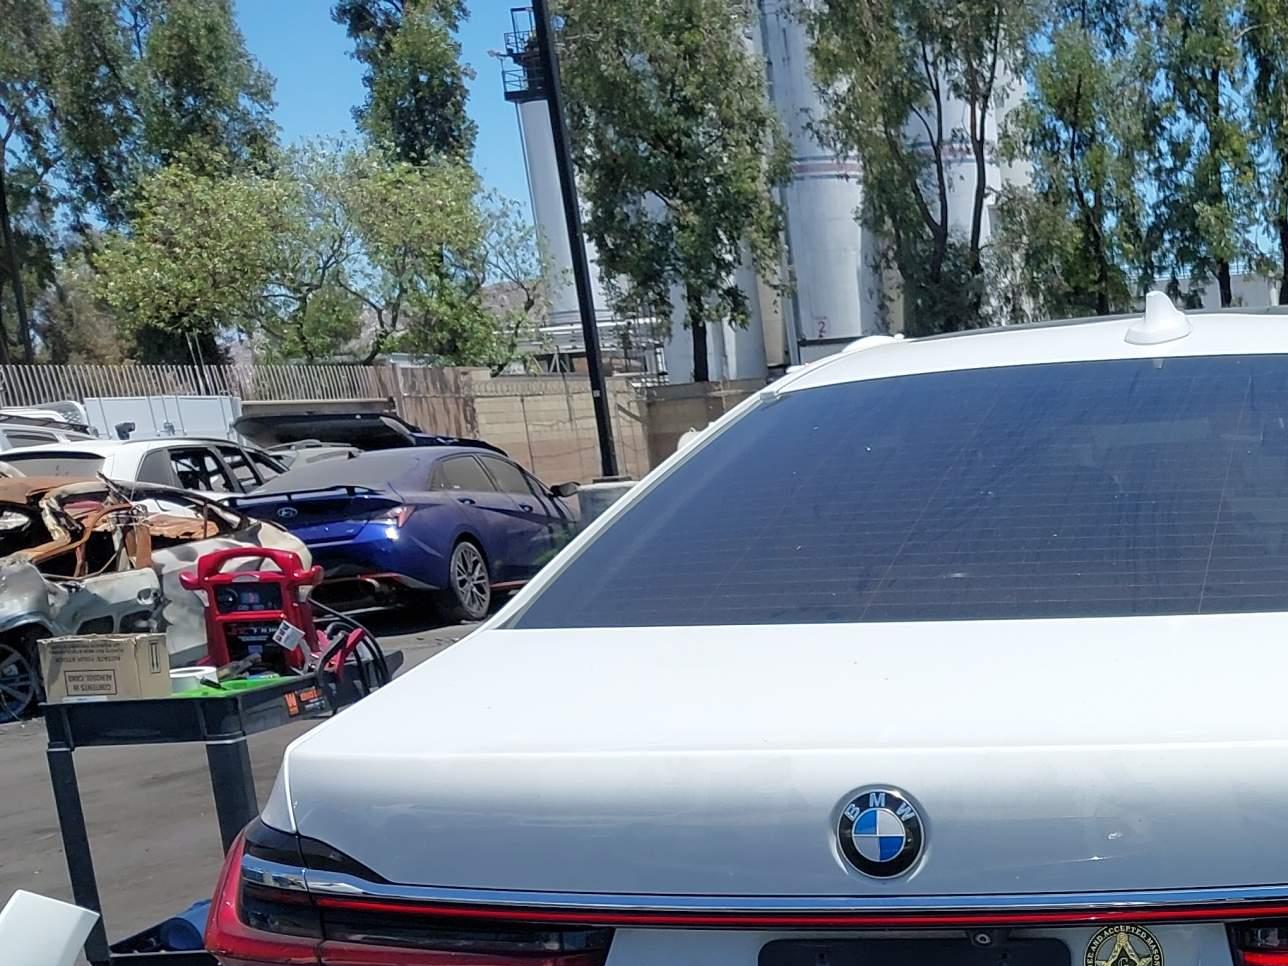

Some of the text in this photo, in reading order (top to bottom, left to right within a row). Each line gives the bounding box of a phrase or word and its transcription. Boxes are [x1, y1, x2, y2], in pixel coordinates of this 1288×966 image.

[844, 792, 915, 822] BMW
[1090, 935, 1104, 952] AND
[1104, 925, 1147, 940] ACCEPTED
